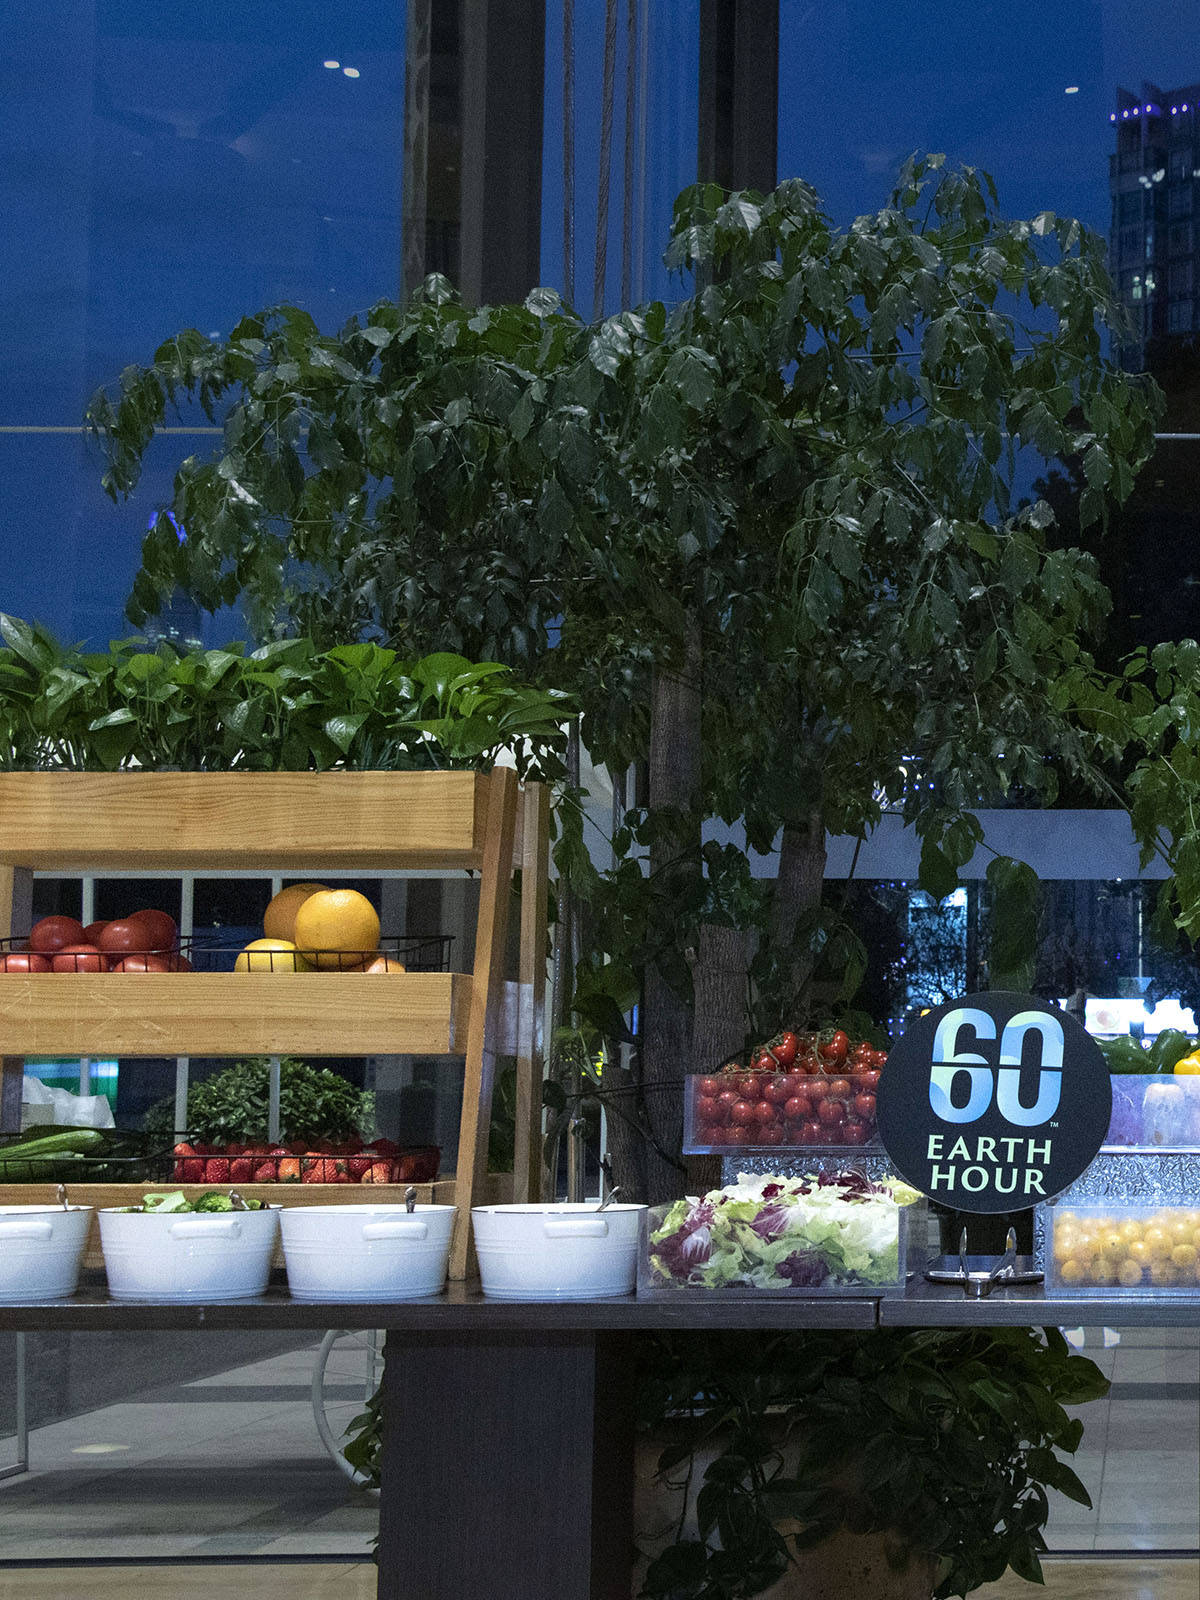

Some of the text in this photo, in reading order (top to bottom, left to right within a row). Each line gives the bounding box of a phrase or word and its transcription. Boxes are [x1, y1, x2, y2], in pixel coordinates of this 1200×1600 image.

[928, 1008, 1065, 1127] 60
[926, 1134, 1052, 1165] EARTH
[930, 1165, 1047, 1195] HOUR
